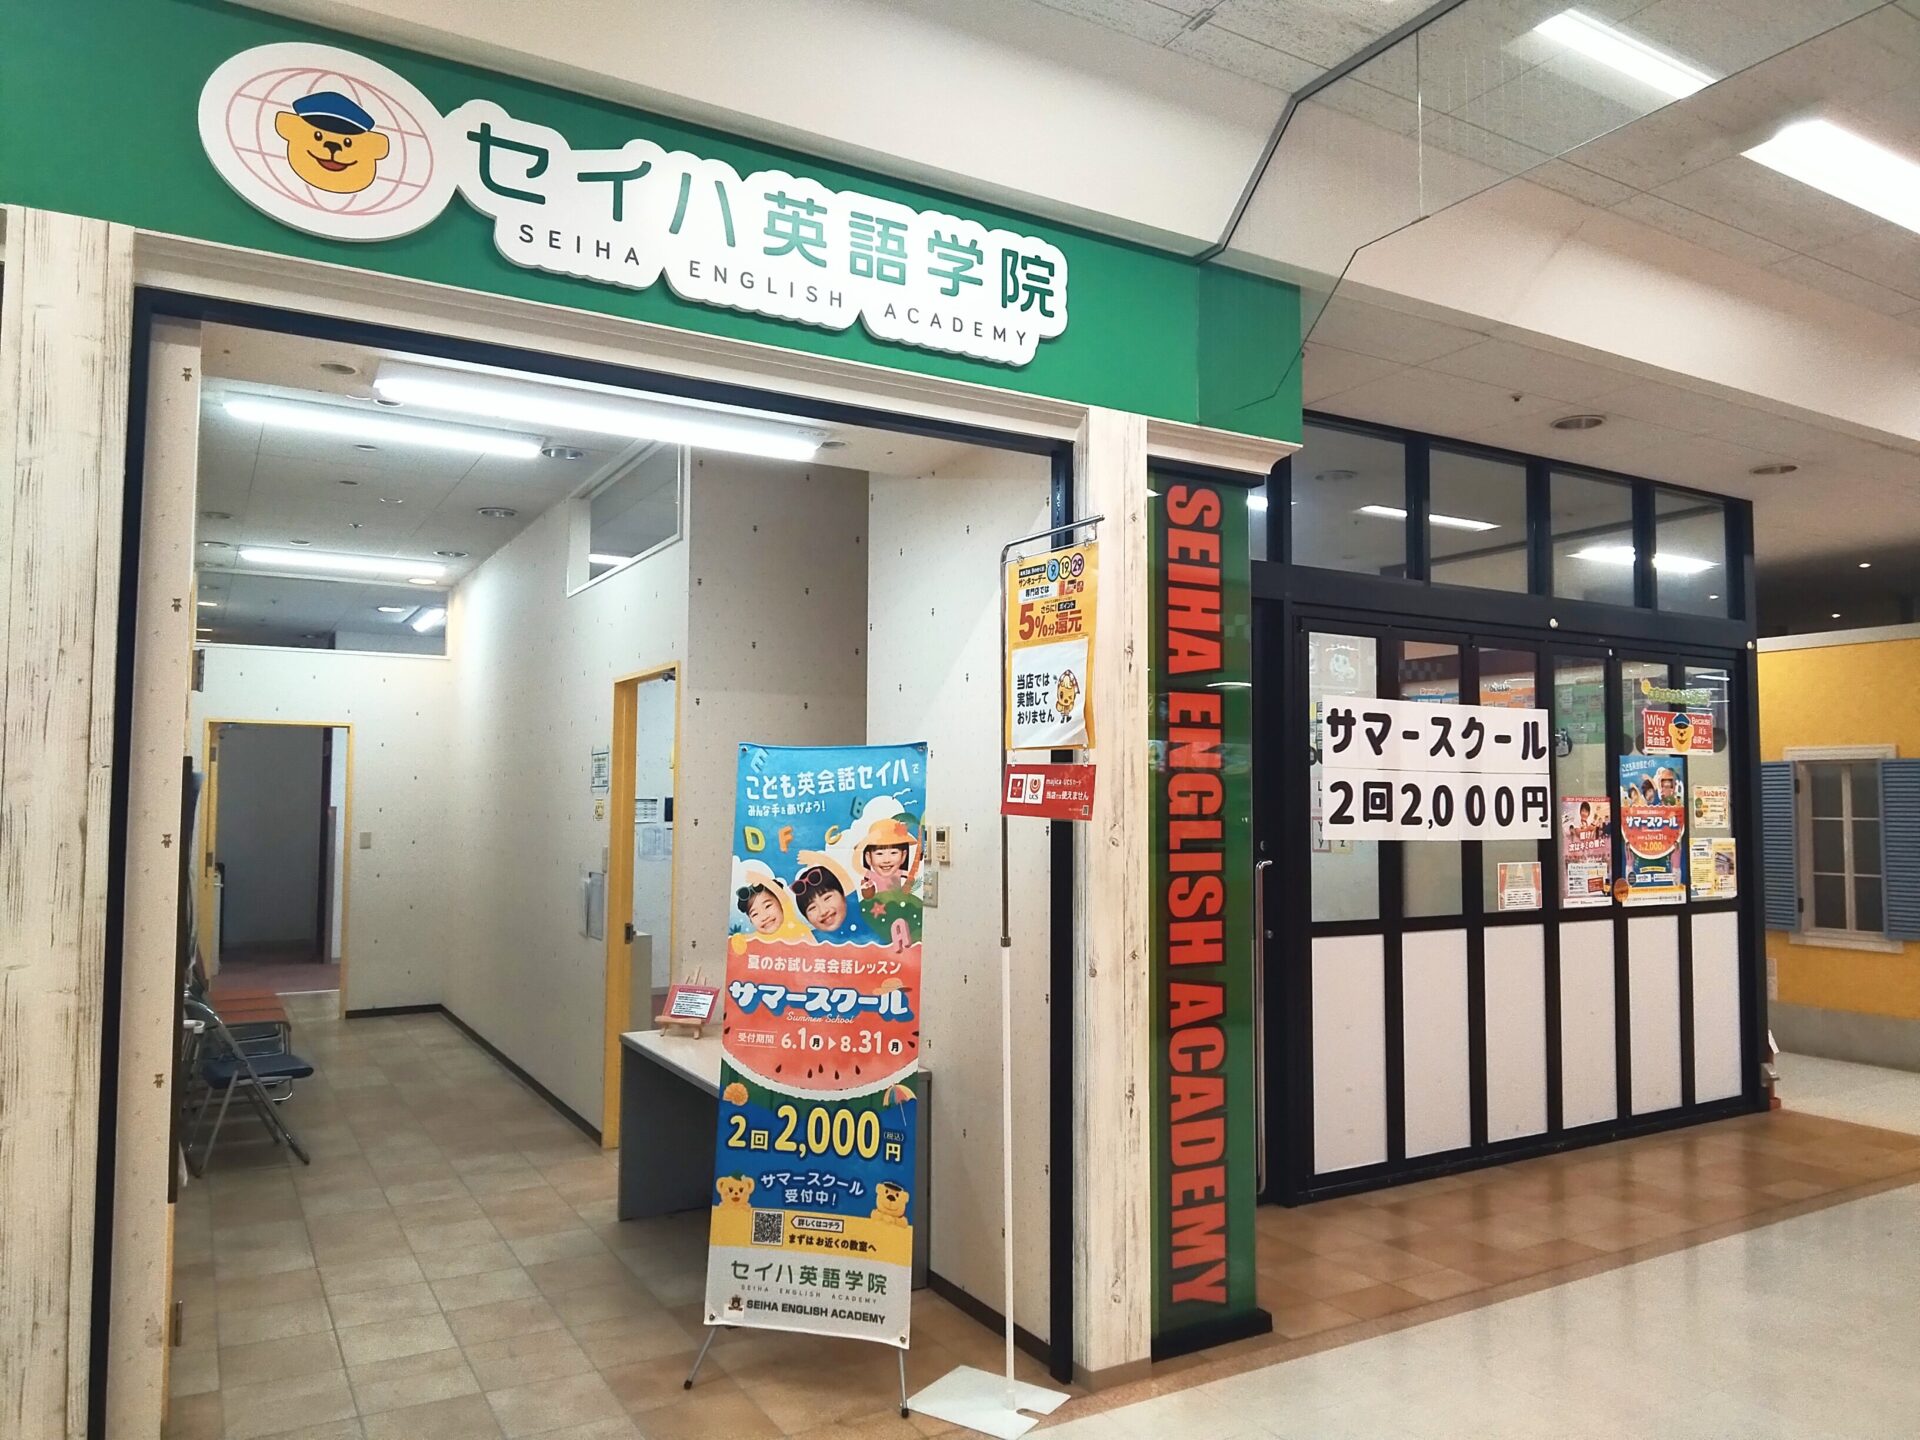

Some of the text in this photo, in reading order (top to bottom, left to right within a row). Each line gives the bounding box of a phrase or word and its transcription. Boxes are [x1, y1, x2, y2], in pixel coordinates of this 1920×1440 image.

[466, 122, 1057, 319] セイハ英語学院
[518, 224, 1030, 346] SEIHA ENGLISH ACADEMY
[1018, 575, 1047, 588] サンキューデー
[1017, 672, 1050, 690] 当店では
[1016, 691, 1050, 708] 実施して
[1017, 708, 1055, 725] おりません
[1646, 713, 1666, 726] Why
[1326, 708, 1547, 760] サマースクール
[1647, 727, 1665, 735] こども
[1647, 736, 1671, 747] 英会話?
[1329, 780, 1548, 830] 2回2,000円
[1625, 815, 1679, 828] サマースクール
[1166, 485, 1228, 1305] SEIHA ENGLISH ACADEMY
[747, 954, 902, 976] 夏のお試し英会話レッスン
[728, 980, 909, 1016] サマースクール
[787, 1011, 855, 1025] Summer School
[737, 1032, 775, 1045] 受付期間
[760, 1171, 865, 1197] サマースクール
[784, 1188, 838, 1207] 受付中!
[797, 1218, 842, 1231] 詳しくはコチラ
[731, 1259, 888, 1296] セイハ英語学院
[741, 1283, 878, 1306] SEIHA ENGLISH ACADEMY
[746, 1299, 886, 1325] SEIHA ENGLISH ACADEMY
